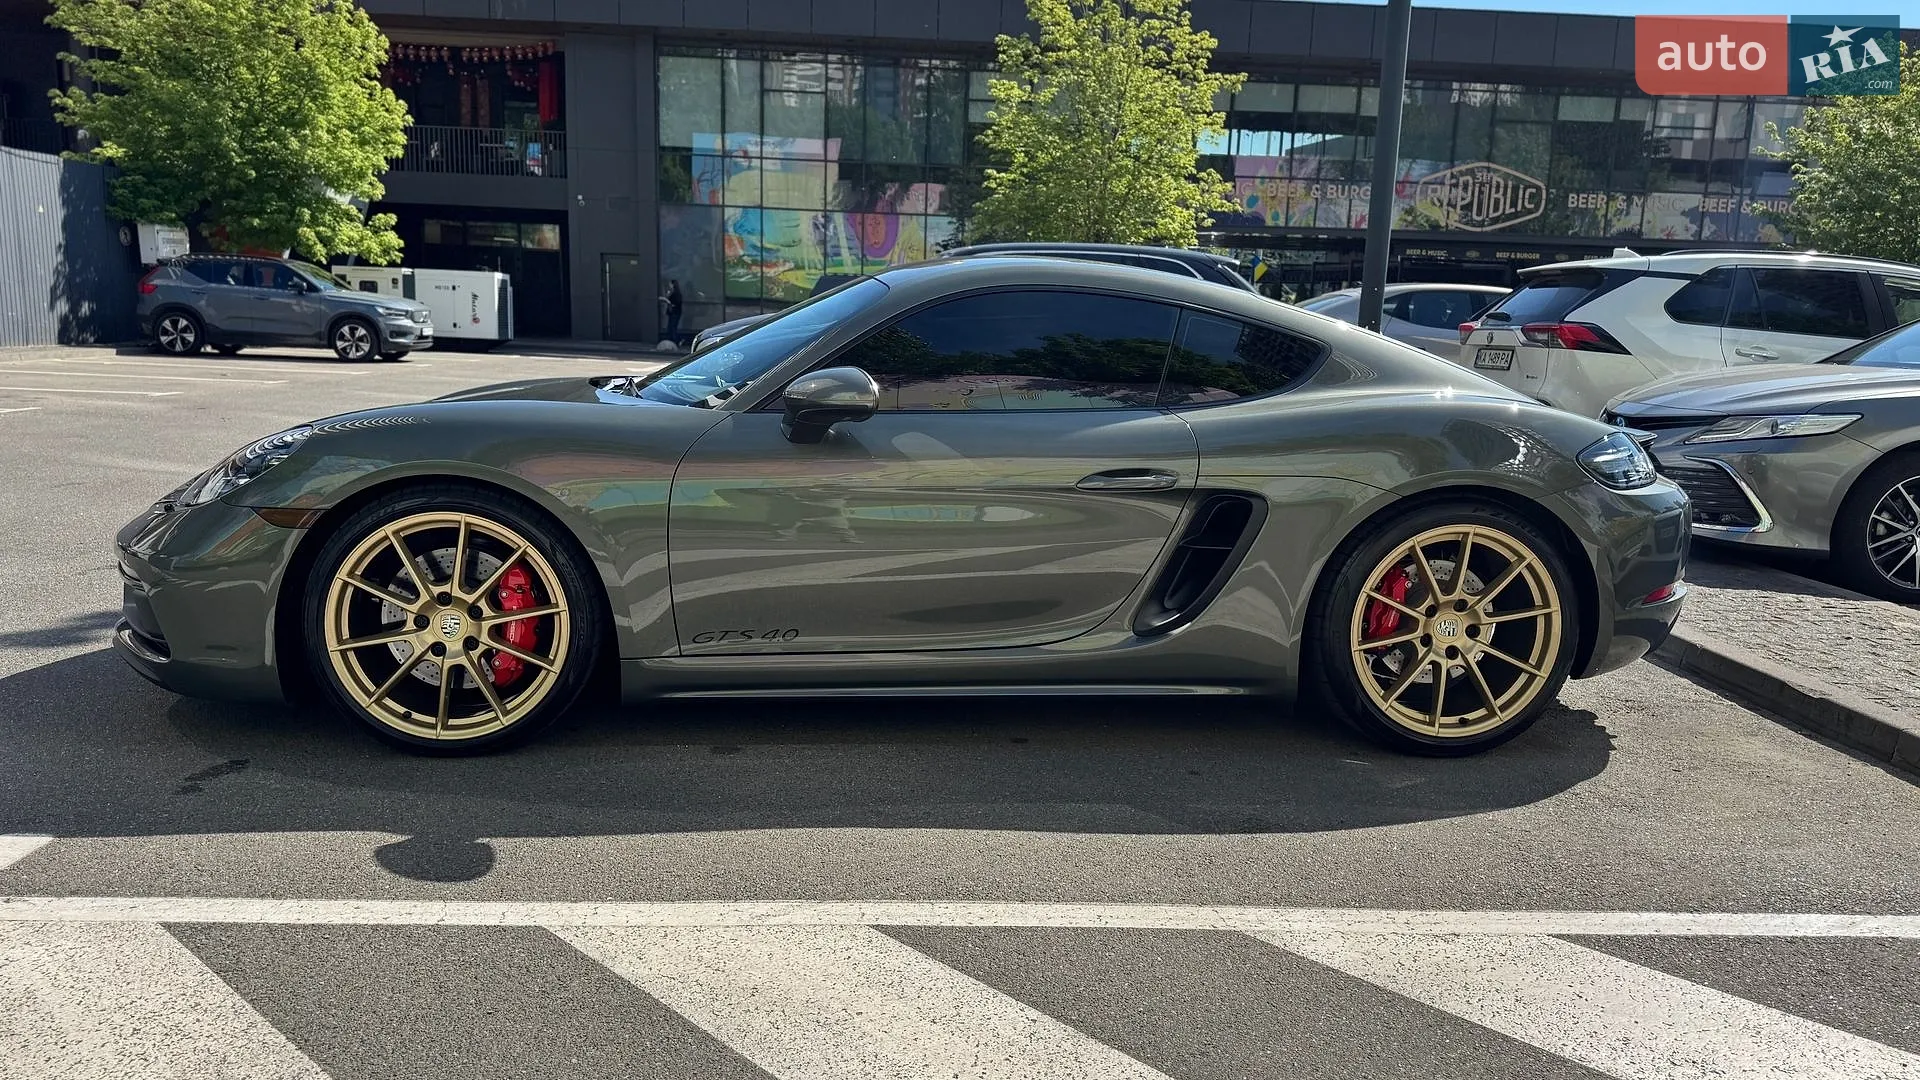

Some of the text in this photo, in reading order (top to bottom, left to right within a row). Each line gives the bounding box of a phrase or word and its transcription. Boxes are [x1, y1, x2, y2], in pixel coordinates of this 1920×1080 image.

[1267, 182, 1306, 198] BEEF
[1311, 184, 1321, 199] &
[1327, 184, 1371, 200] BURG
[1568, 193, 1607, 208] BEER
[1617, 195, 1627, 208] &
[1698, 197, 1737, 213] BEEF
[1740, 200, 1752, 214] &
[1517, 252, 1540, 260] BURGER
[692, 628, 800, 644] GTS 4.0
